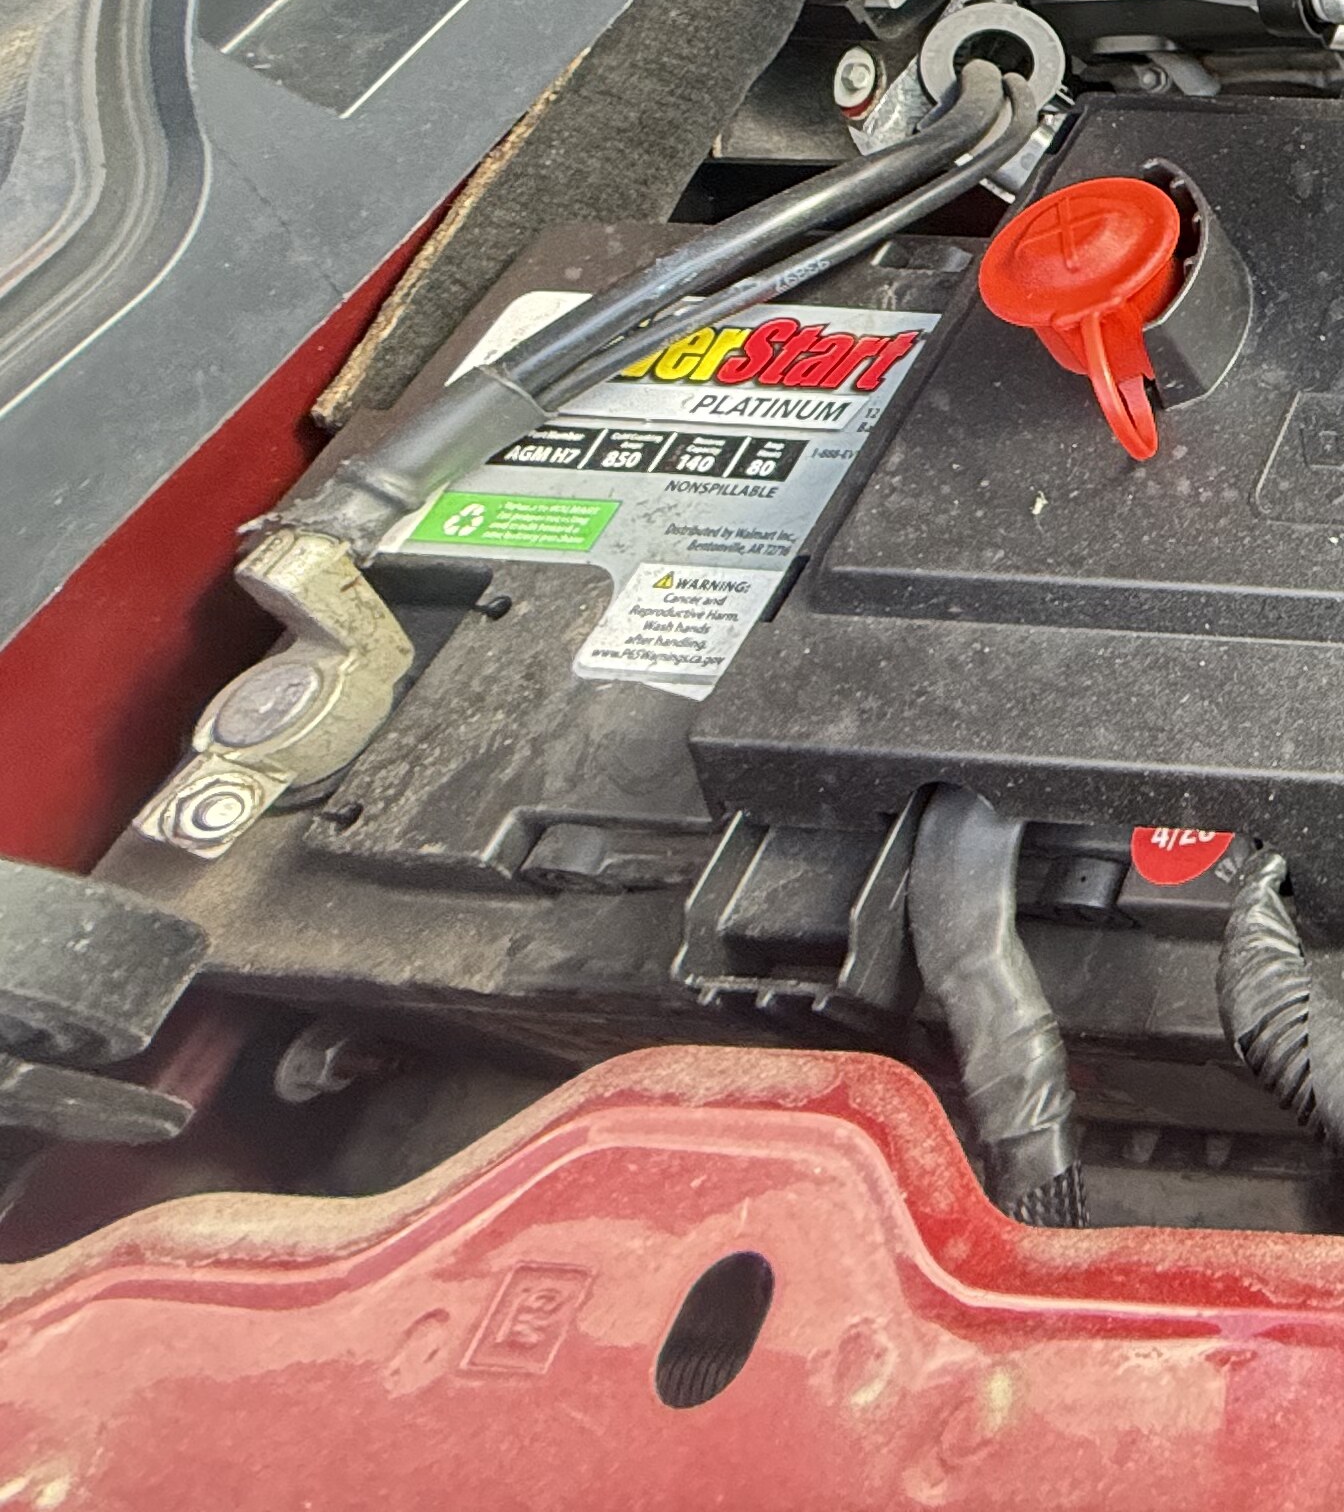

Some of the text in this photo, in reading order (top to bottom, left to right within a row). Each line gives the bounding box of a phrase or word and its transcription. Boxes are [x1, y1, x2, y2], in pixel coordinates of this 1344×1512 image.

[621, 315, 923, 393] erStart
[689, 394, 851, 422] PLATINUM
[503, 445, 582, 465] AGM H7
[600, 450, 642, 469] 850
[676, 454, 715, 473] 140
[746, 458, 777, 477] 80
[664, 479, 780, 499] NONSPILLABLE
[735, 527, 777, 541] Walmart
[675, 577, 751, 593] WARNING:
[663, 592, 727, 606] Cancer and
[628, 604, 705, 620] Reproductive
[643, 620, 711, 635] Wash hands
[624, 634, 655, 646] after
